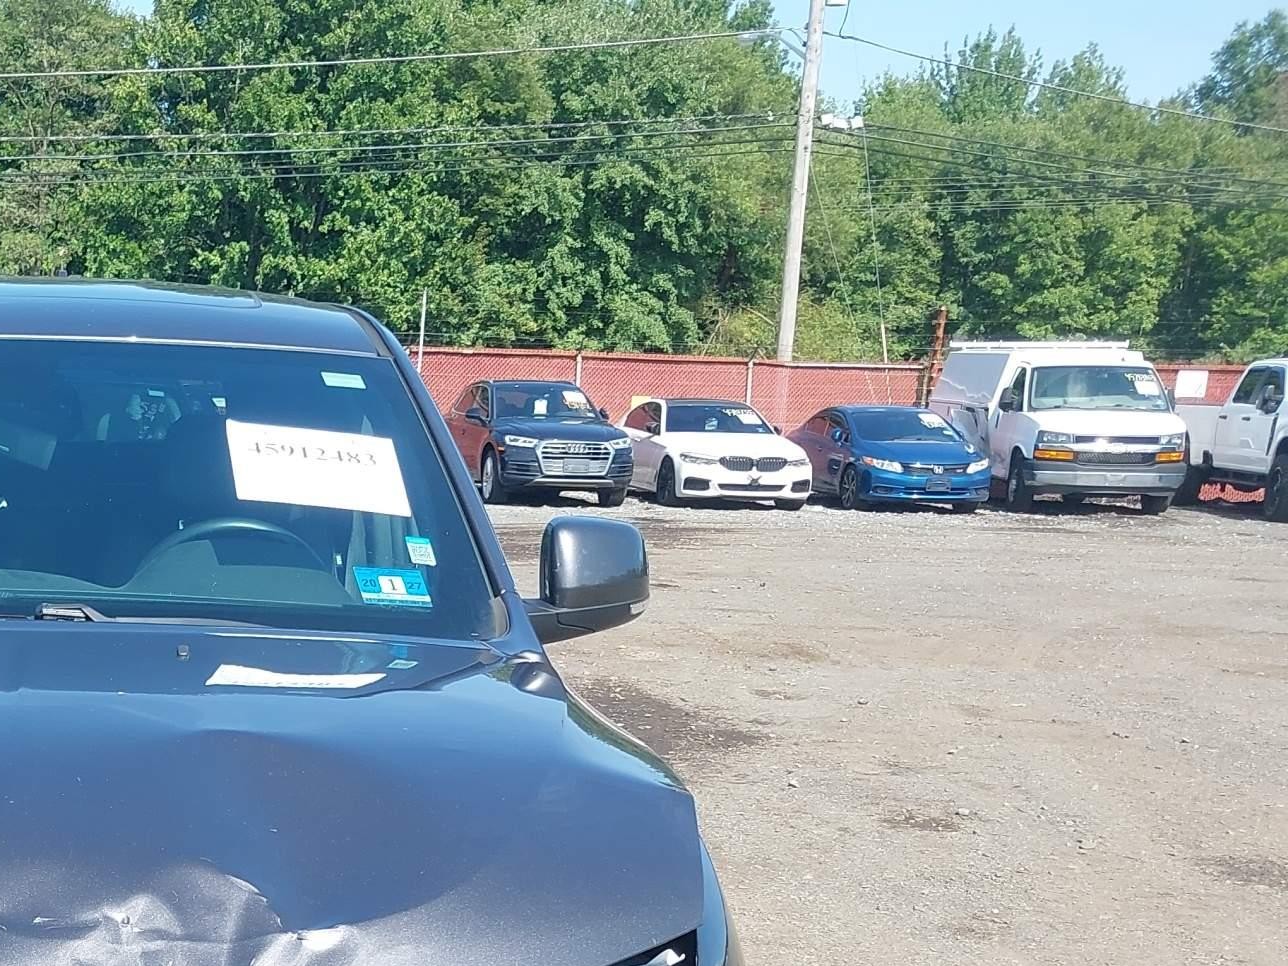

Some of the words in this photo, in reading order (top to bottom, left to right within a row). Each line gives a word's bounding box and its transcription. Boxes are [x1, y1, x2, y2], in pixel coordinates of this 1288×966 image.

[361, 578, 377, 588] 20
[387, 578, 399, 591] 1
[406, 581, 422, 590] 27
